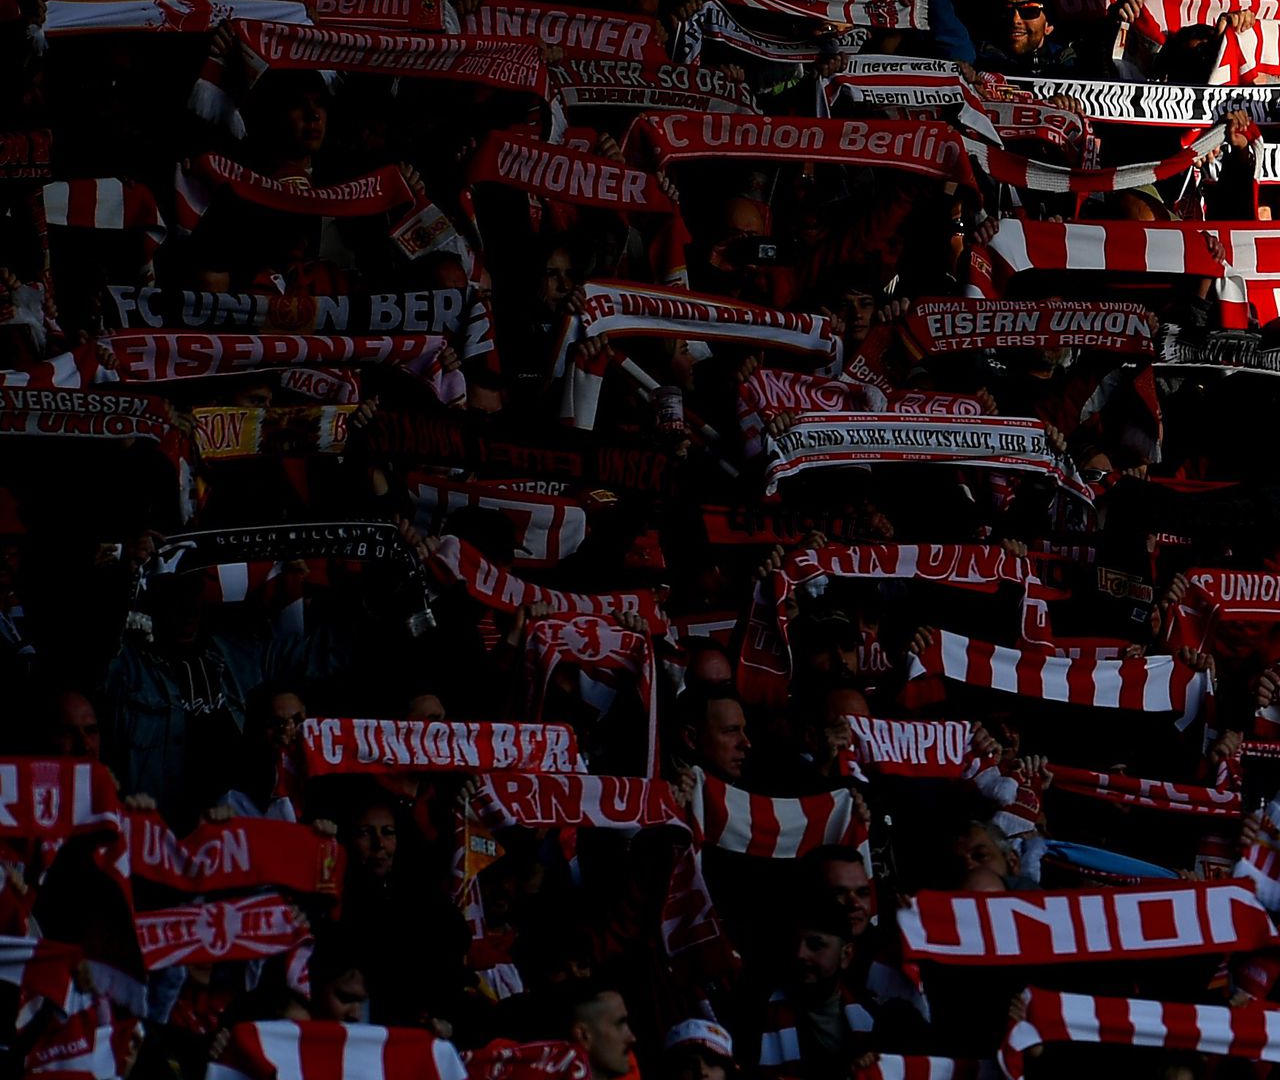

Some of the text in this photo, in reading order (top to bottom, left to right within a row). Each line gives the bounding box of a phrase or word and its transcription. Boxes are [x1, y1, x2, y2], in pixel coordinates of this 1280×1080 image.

[375, 31, 466, 70] BERLIN
[862, 61, 905, 74] never
[861, 89, 964, 104] Eisern Union
[702, 118, 832, 152] Union
[928, 310, 1152, 336] EISERN UNION
[995, 334, 1125, 349] ERST RECHT
[808, 429, 1025, 451] SIND EURE IHR
[352, 726, 482, 768] UNION
[905, 886, 1262, 958] UNION
